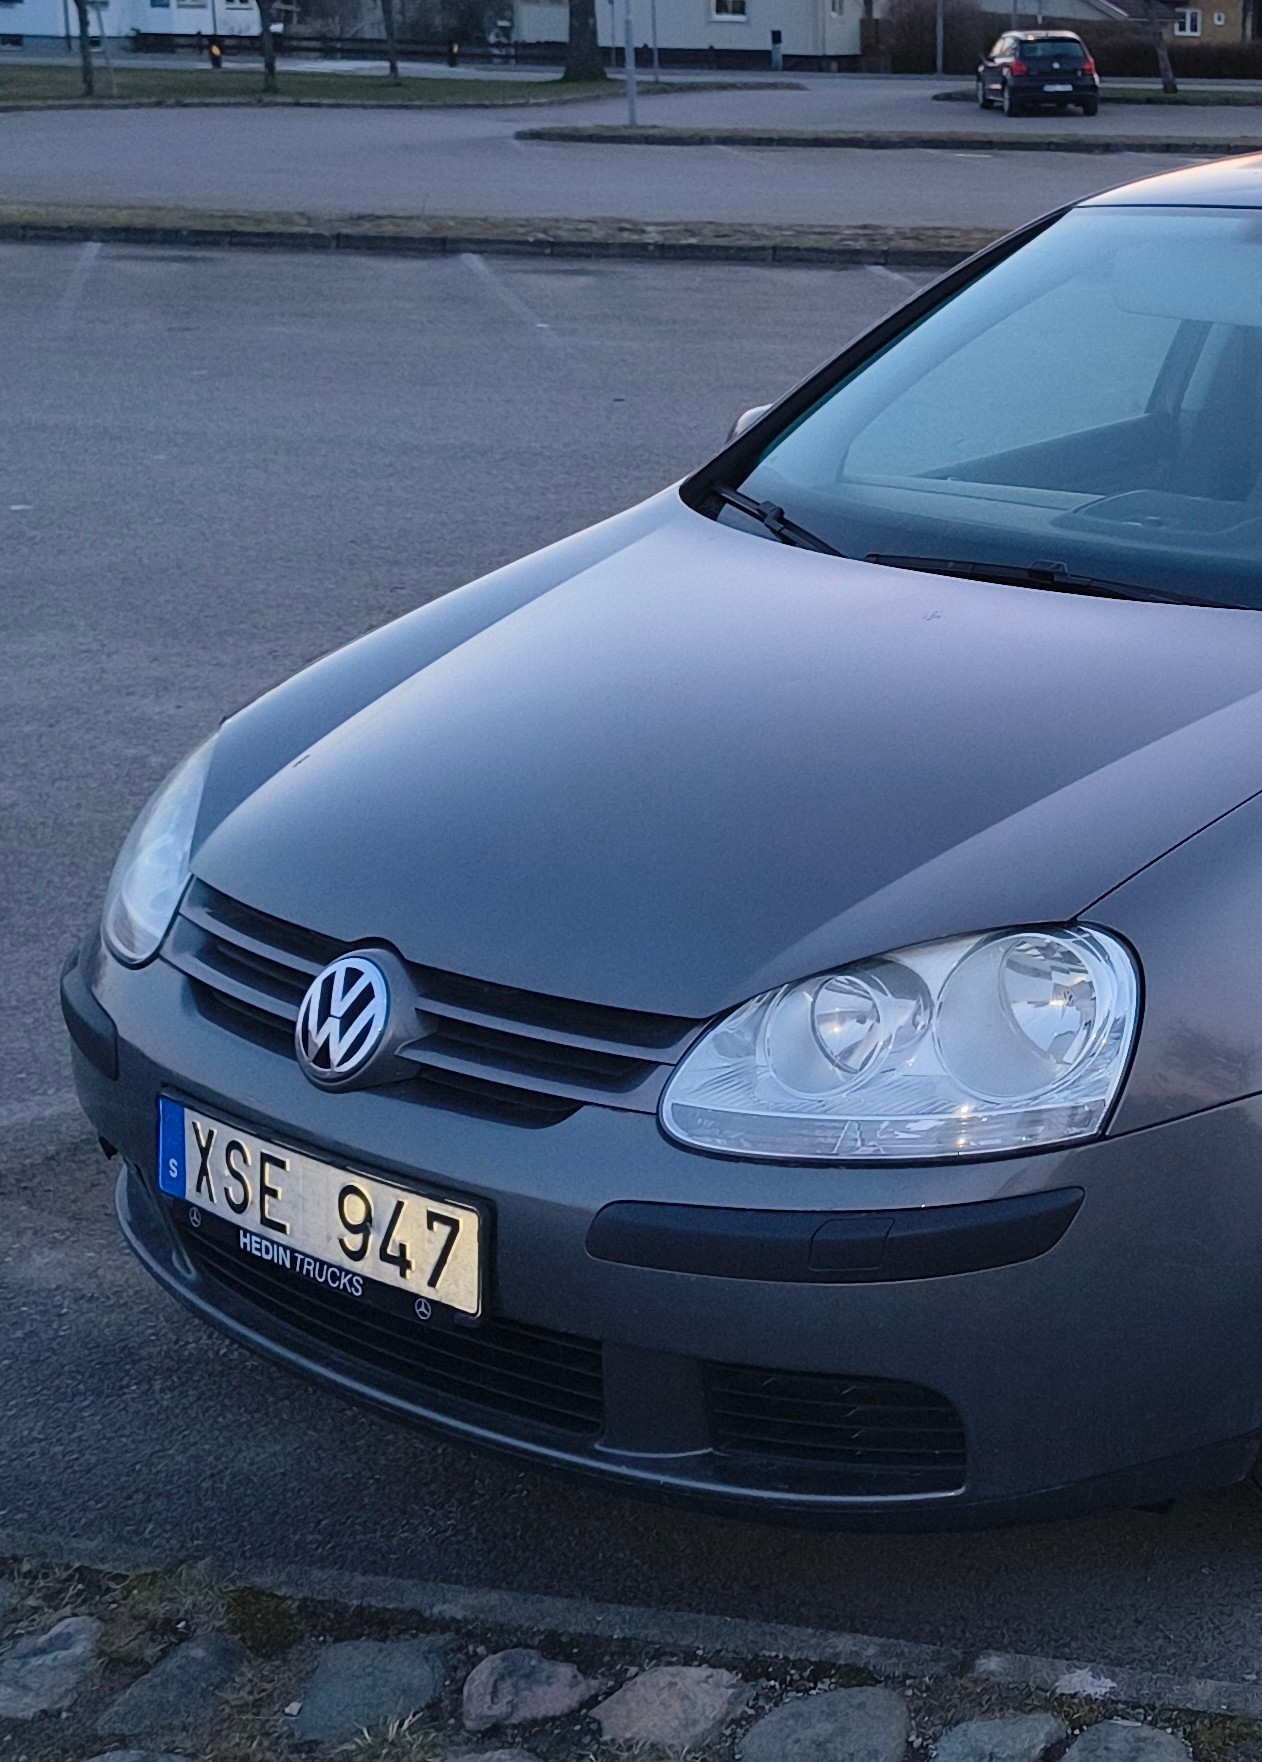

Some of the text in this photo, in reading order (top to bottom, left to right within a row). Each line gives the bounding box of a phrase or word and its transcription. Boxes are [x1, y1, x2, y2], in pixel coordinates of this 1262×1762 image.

[303, 960, 385, 1072] VW
[168, 1158, 179, 1179] S
[191, 1120, 464, 1290] XSE 947
[239, 1230, 364, 1298] HEDIN TRUCKS
